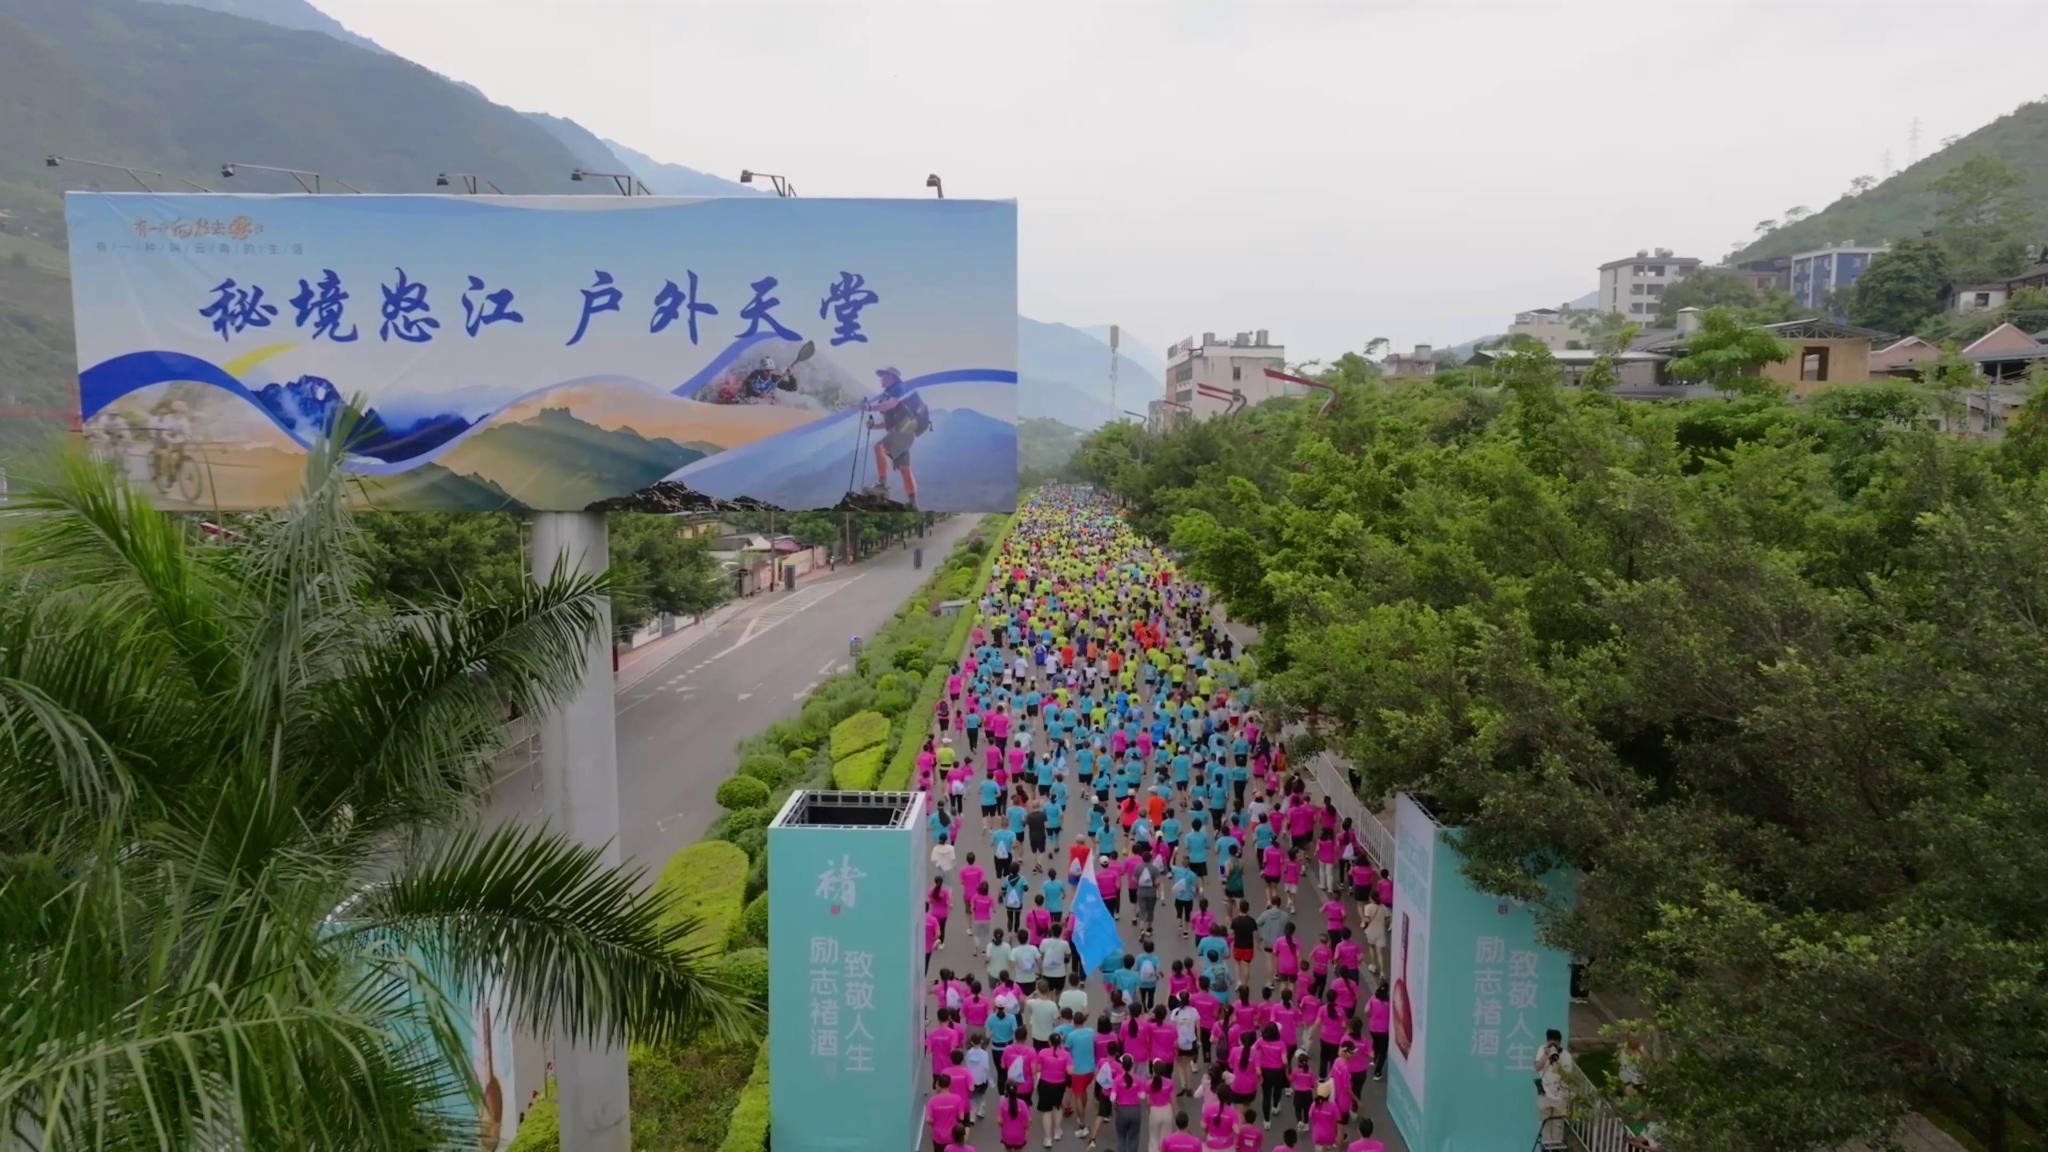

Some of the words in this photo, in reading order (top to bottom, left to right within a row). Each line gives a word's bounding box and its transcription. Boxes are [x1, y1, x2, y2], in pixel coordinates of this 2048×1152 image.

[199, 266, 525, 343] 秘境怒江
[565, 269, 879, 347] 户外天堂
[809, 935, 840, 1057] 励志褚酒
[844, 950, 875, 1071] 致敬人生
[1470, 935, 1505, 1057] 励志褚酒
[1505, 949, 1540, 1071] 致敬人生
